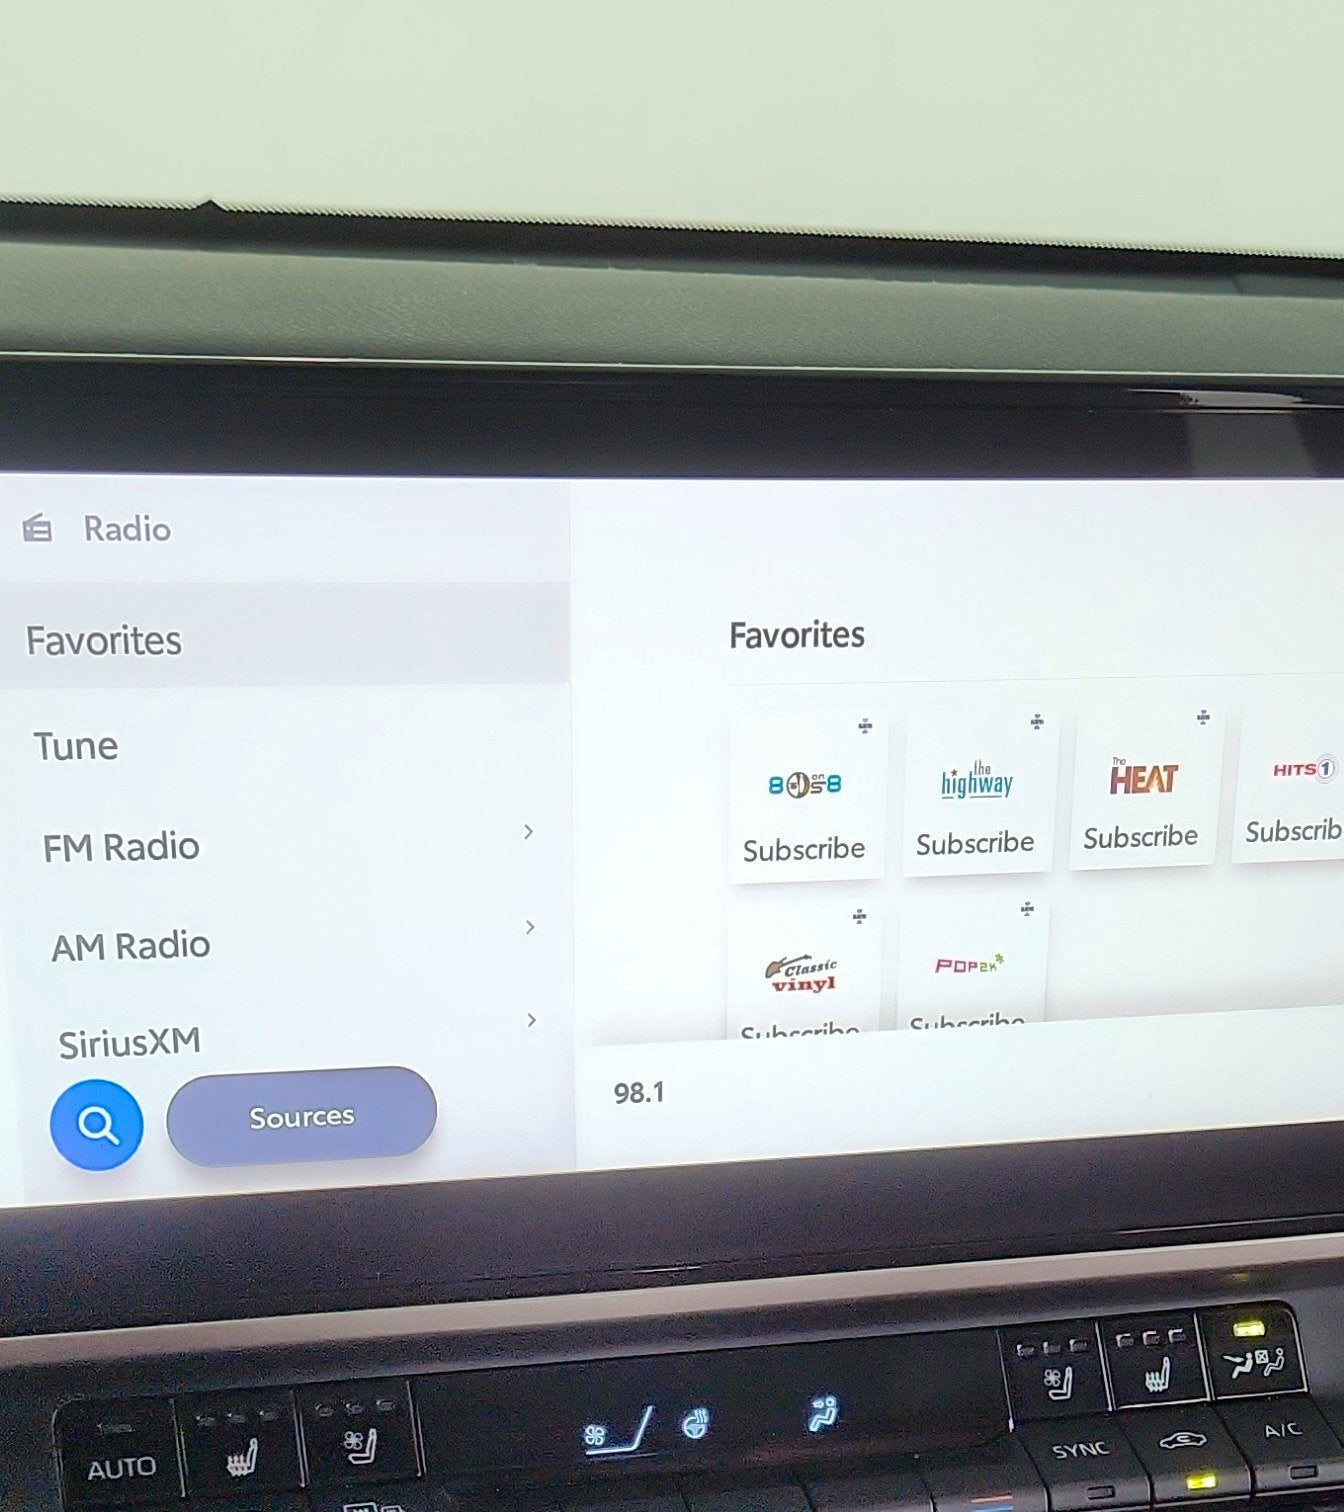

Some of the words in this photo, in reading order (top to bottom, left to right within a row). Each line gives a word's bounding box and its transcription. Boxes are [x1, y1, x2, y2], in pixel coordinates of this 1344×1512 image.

[84, 514, 171, 542] Radio
[26, 623, 182, 656] Favorites
[730, 618, 865, 650] Favorites
[33, 731, 119, 761] Tune
[973, 759, 991, 776] the
[1109, 764, 1179, 796] HEAT
[1273, 763, 1317, 777] HITS
[940, 769, 1014, 800] highway
[43, 833, 93, 863] FM
[104, 829, 200, 862] Radio
[743, 835, 866, 863] Subscribe
[916, 829, 1035, 856] Subscribe
[1083, 823, 1199, 850] Subscribe
[51, 933, 105, 963] AM
[116, 928, 211, 960] Radio
[784, 958, 837, 977] Classic
[772, 974, 836, 994] vinyl
[59, 1026, 200, 1060] SiriusXM
[613, 1080, 663, 1105] 98.1
[250, 1107, 355, 1130] Sources
[1264, 1422, 1303, 1438] A/C
[1052, 1441, 1111, 1460] SYNC
[87, 1455, 156, 1481] AUTO
